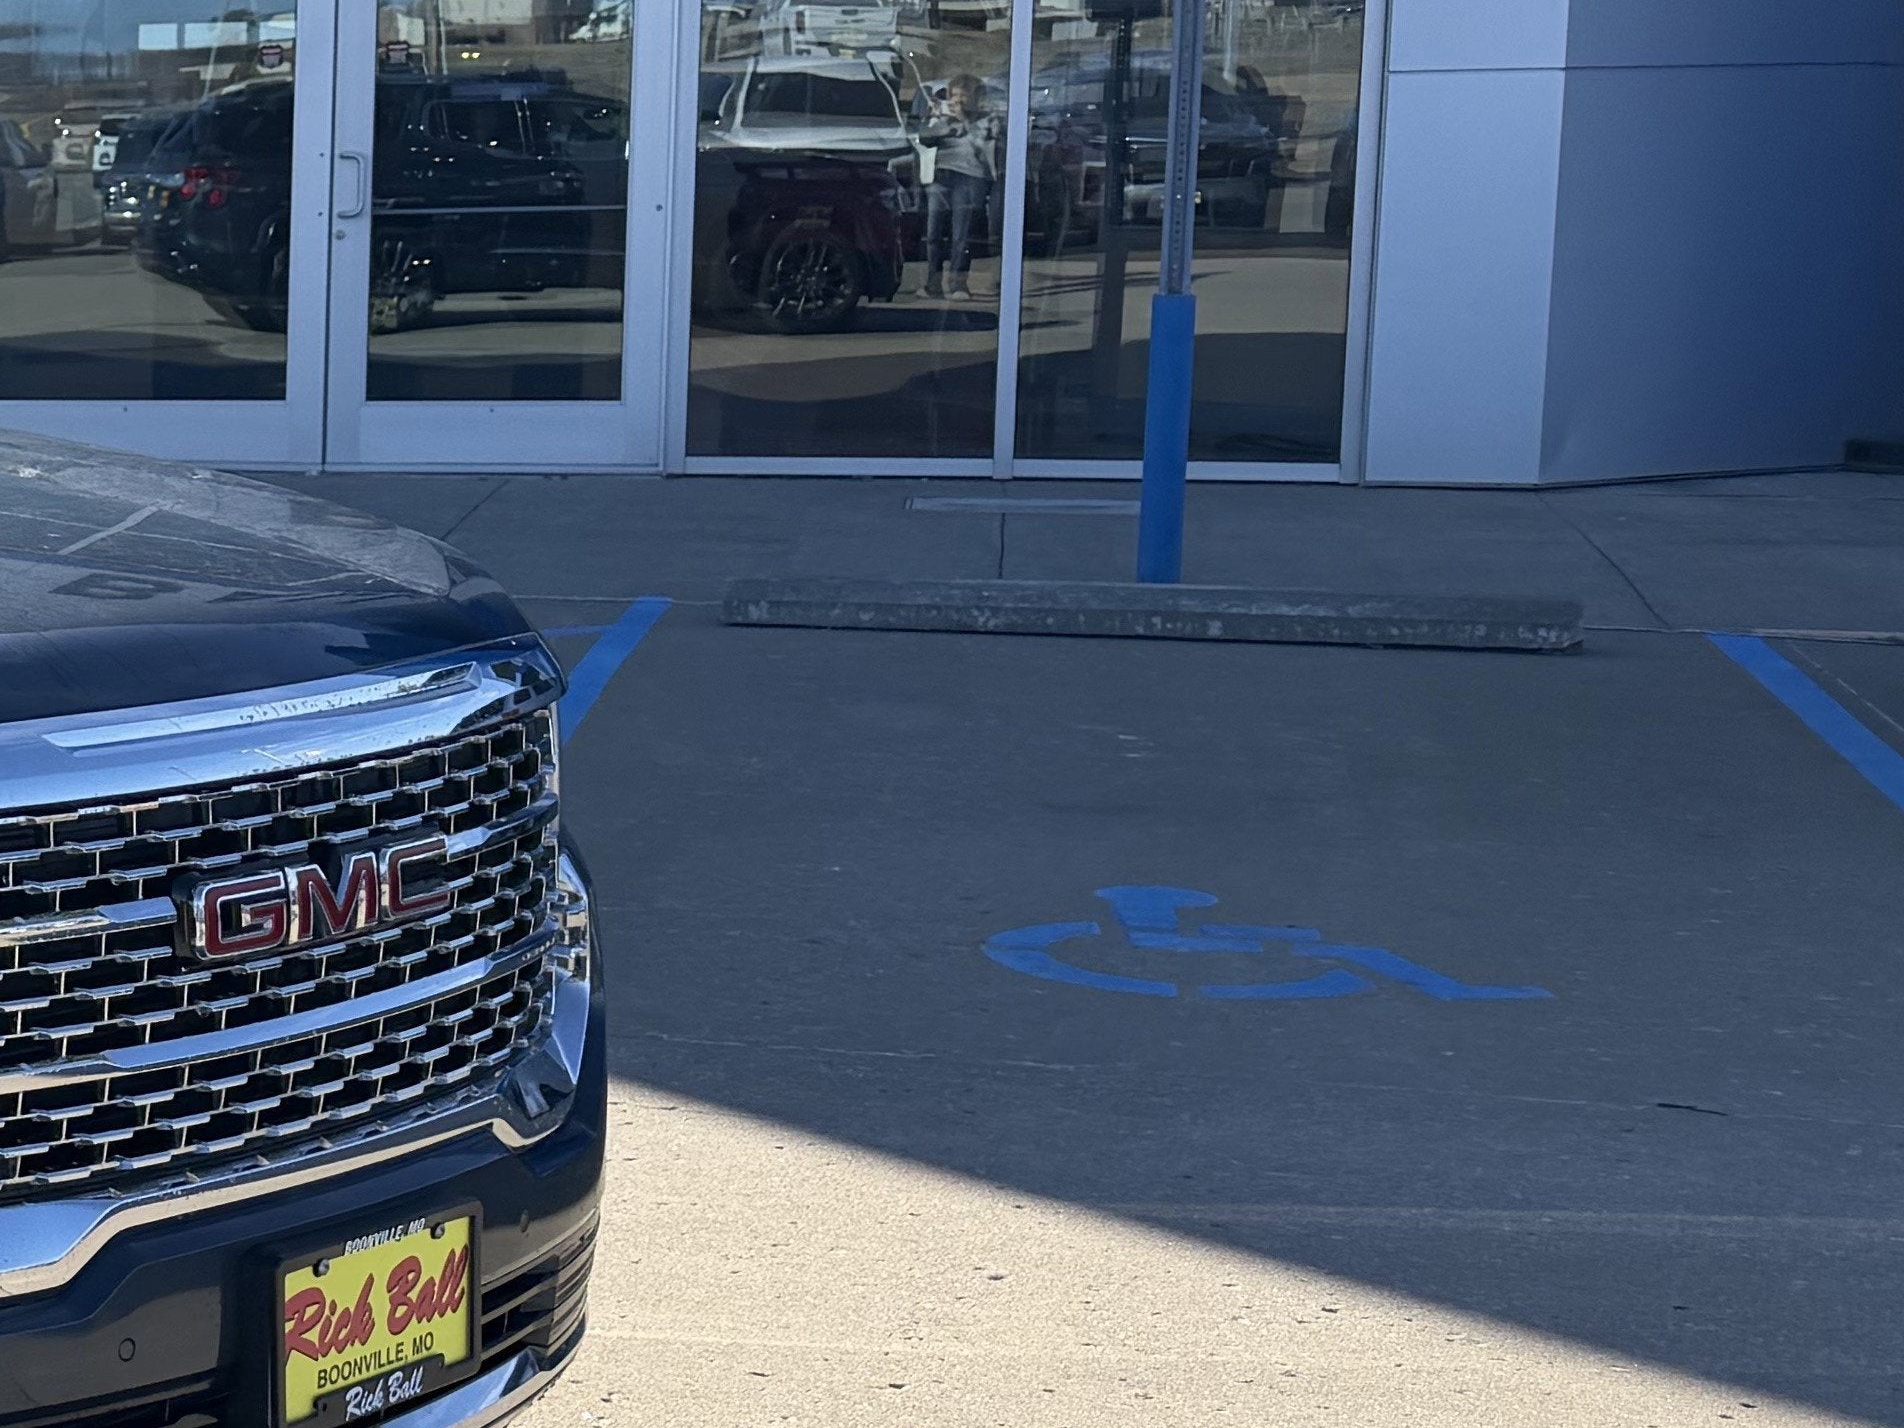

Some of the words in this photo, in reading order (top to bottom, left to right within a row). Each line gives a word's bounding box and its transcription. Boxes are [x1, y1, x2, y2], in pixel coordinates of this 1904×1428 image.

[193, 834, 451, 961] GMC
[285, 1272, 375, 1368] Rick
[386, 1243, 469, 1336] Ball
[317, 1341, 408, 1389] BOONVILLE,
[412, 1331, 434, 1355] MO
[345, 1378, 384, 1422] Rick
[388, 1365, 423, 1403] Ball
